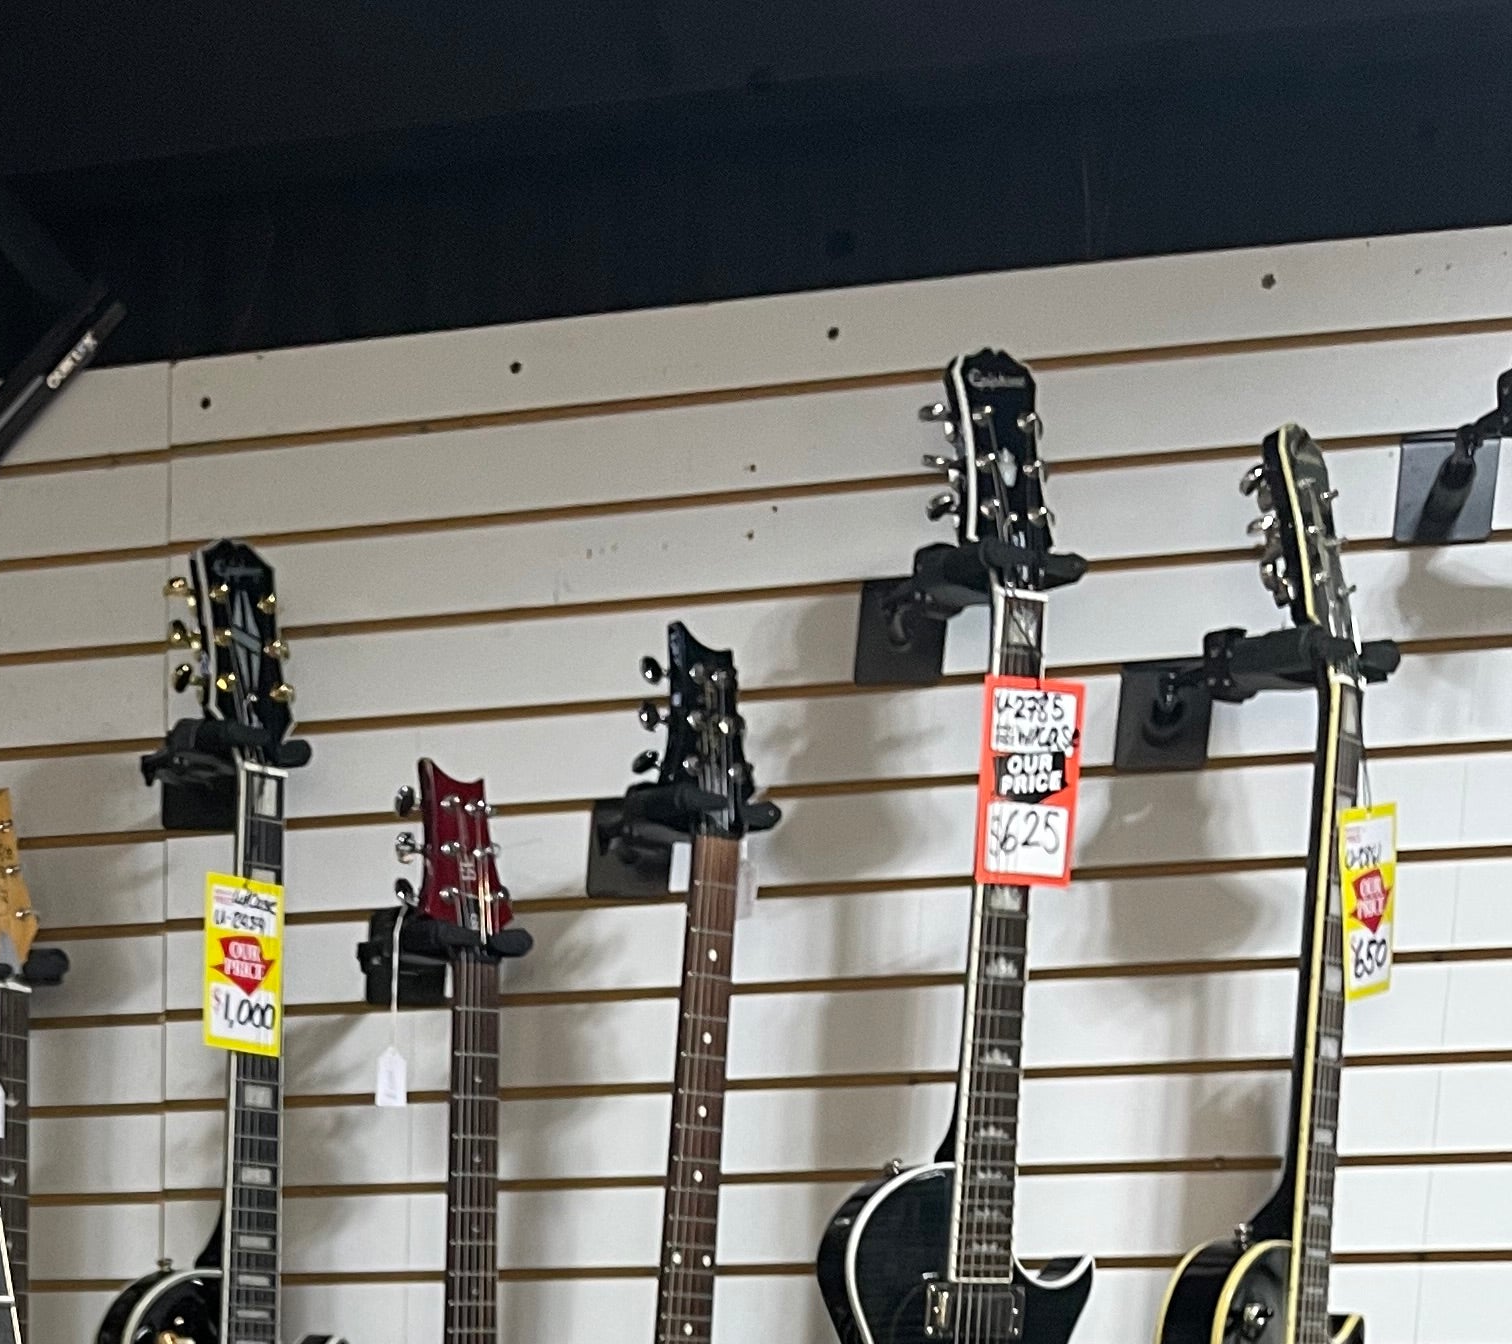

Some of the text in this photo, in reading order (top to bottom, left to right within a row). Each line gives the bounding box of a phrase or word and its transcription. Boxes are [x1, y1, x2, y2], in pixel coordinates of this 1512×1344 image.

[1006, 753, 1054, 776] OUR
[1000, 769, 1064, 796] PRICE
[228, 940, 262, 963] OUR
[223, 956, 267, 981] PRICE
